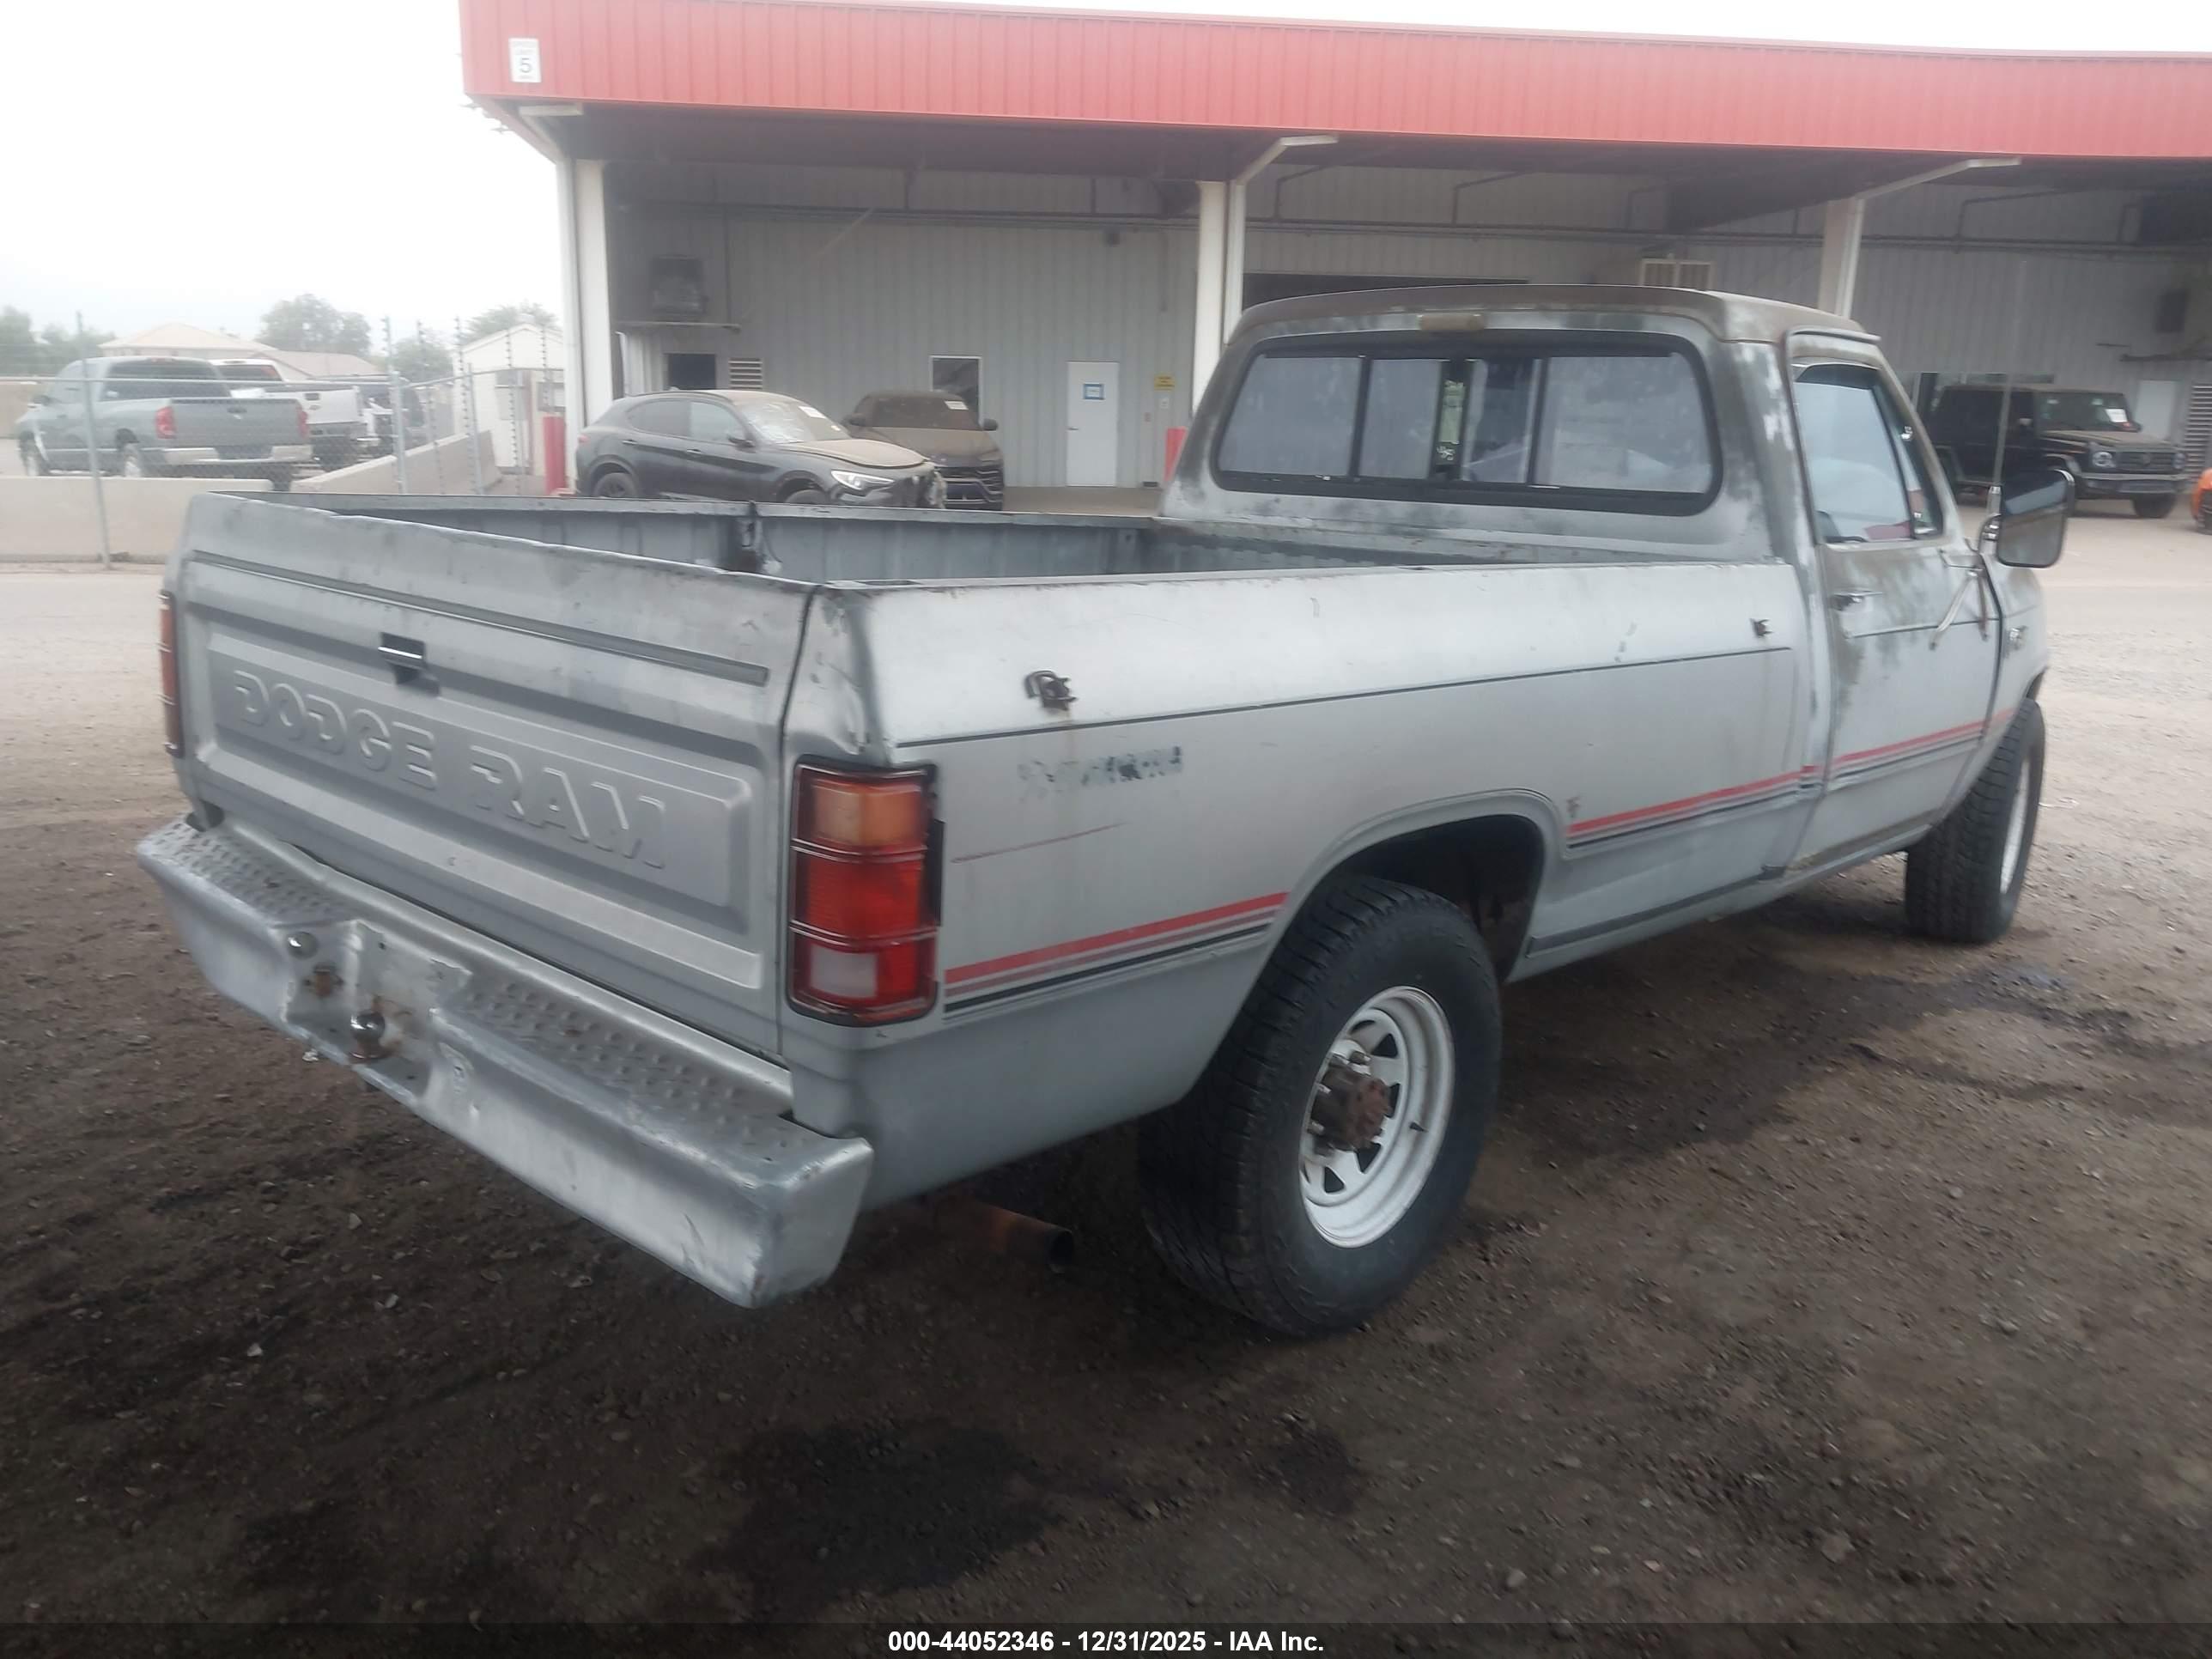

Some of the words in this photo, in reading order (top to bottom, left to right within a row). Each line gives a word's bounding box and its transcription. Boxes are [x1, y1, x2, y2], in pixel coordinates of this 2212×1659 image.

[520, 57, 532, 74] 5
[234, 670, 435, 789] DODGE
[471, 744, 666, 869] RAM
